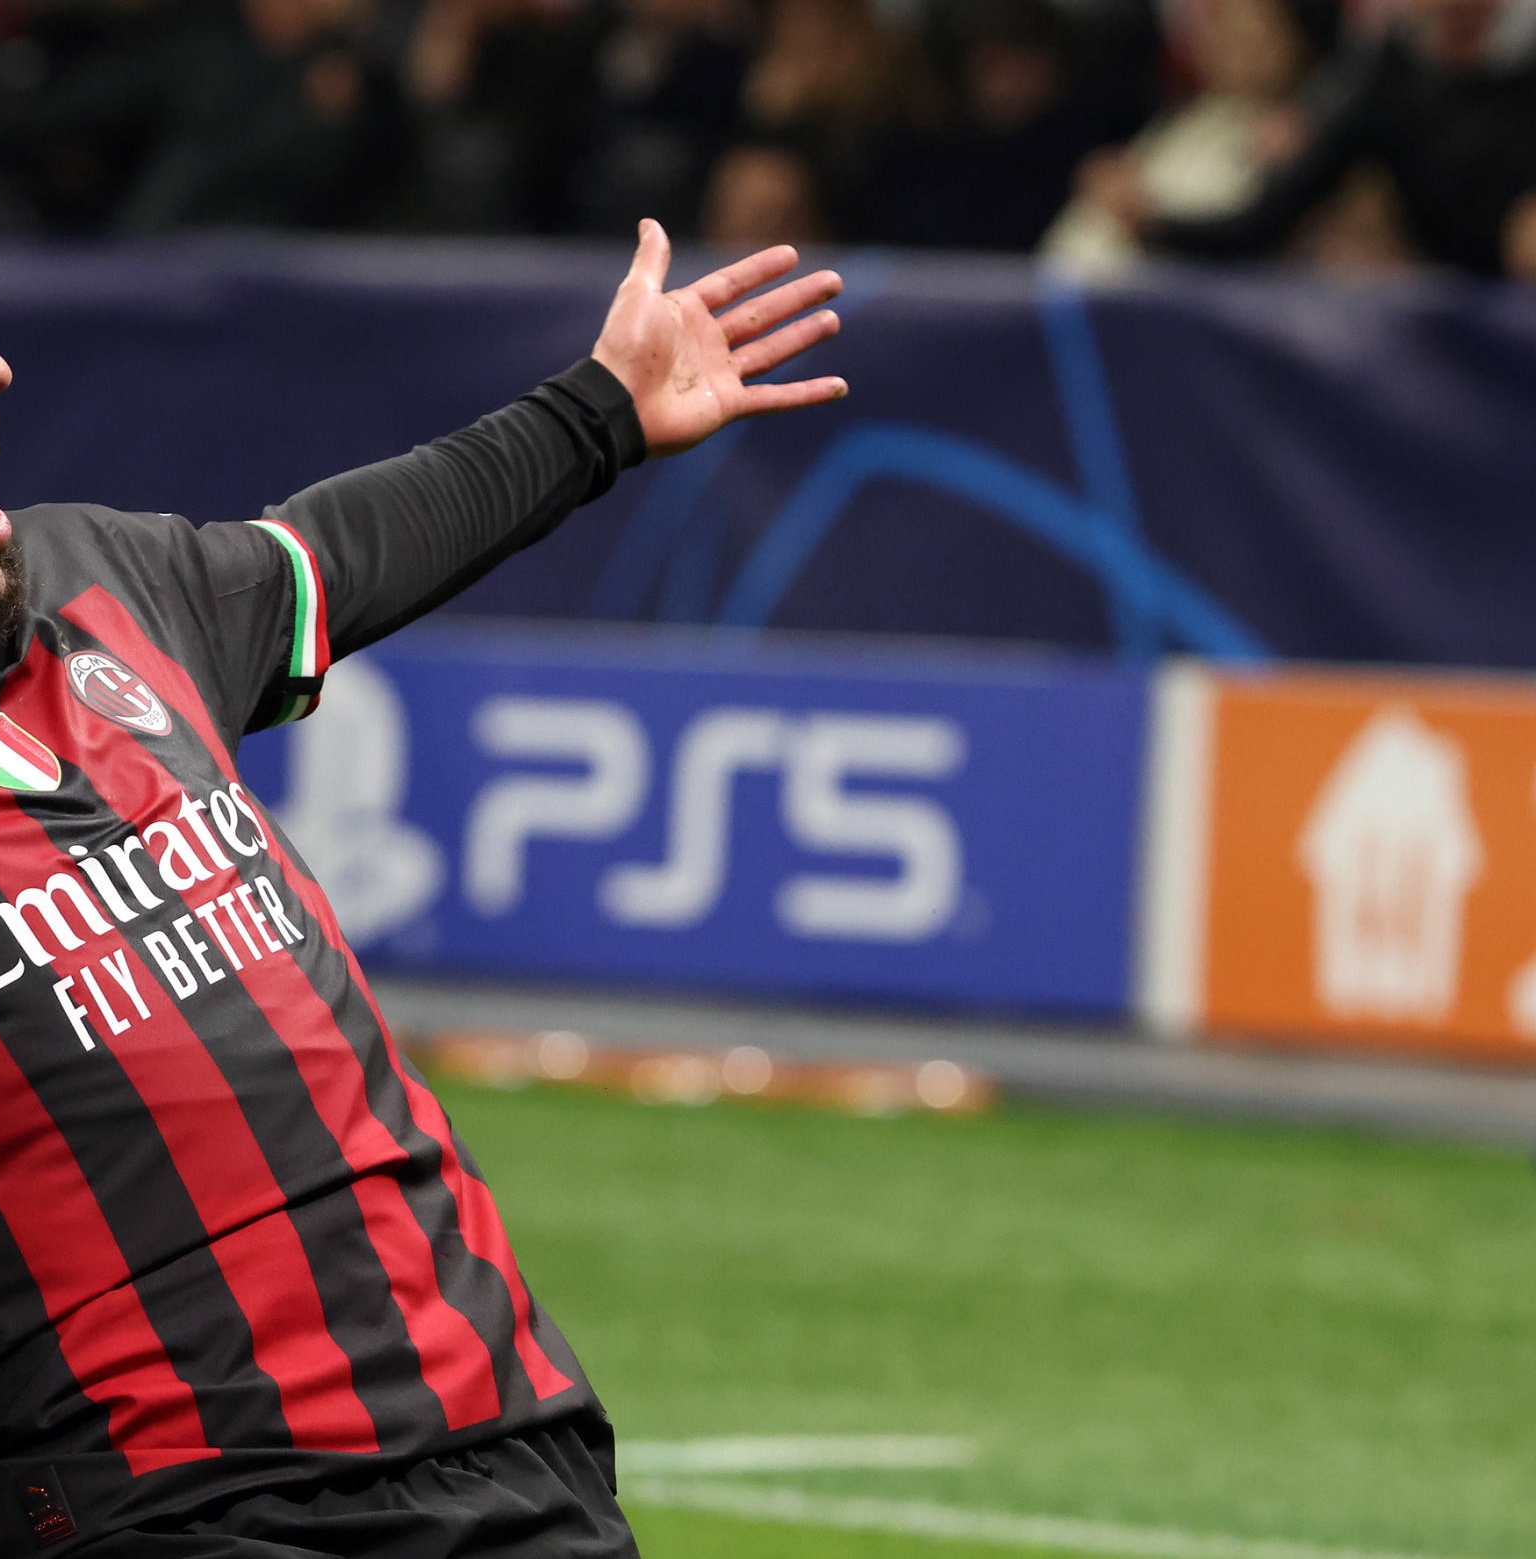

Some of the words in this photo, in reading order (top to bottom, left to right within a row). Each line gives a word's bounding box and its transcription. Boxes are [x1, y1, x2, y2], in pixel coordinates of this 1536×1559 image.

[463, 696, 968, 943] PS5
[52, 948, 152, 1052] FLY
[142, 876, 305, 1000] BETTER
